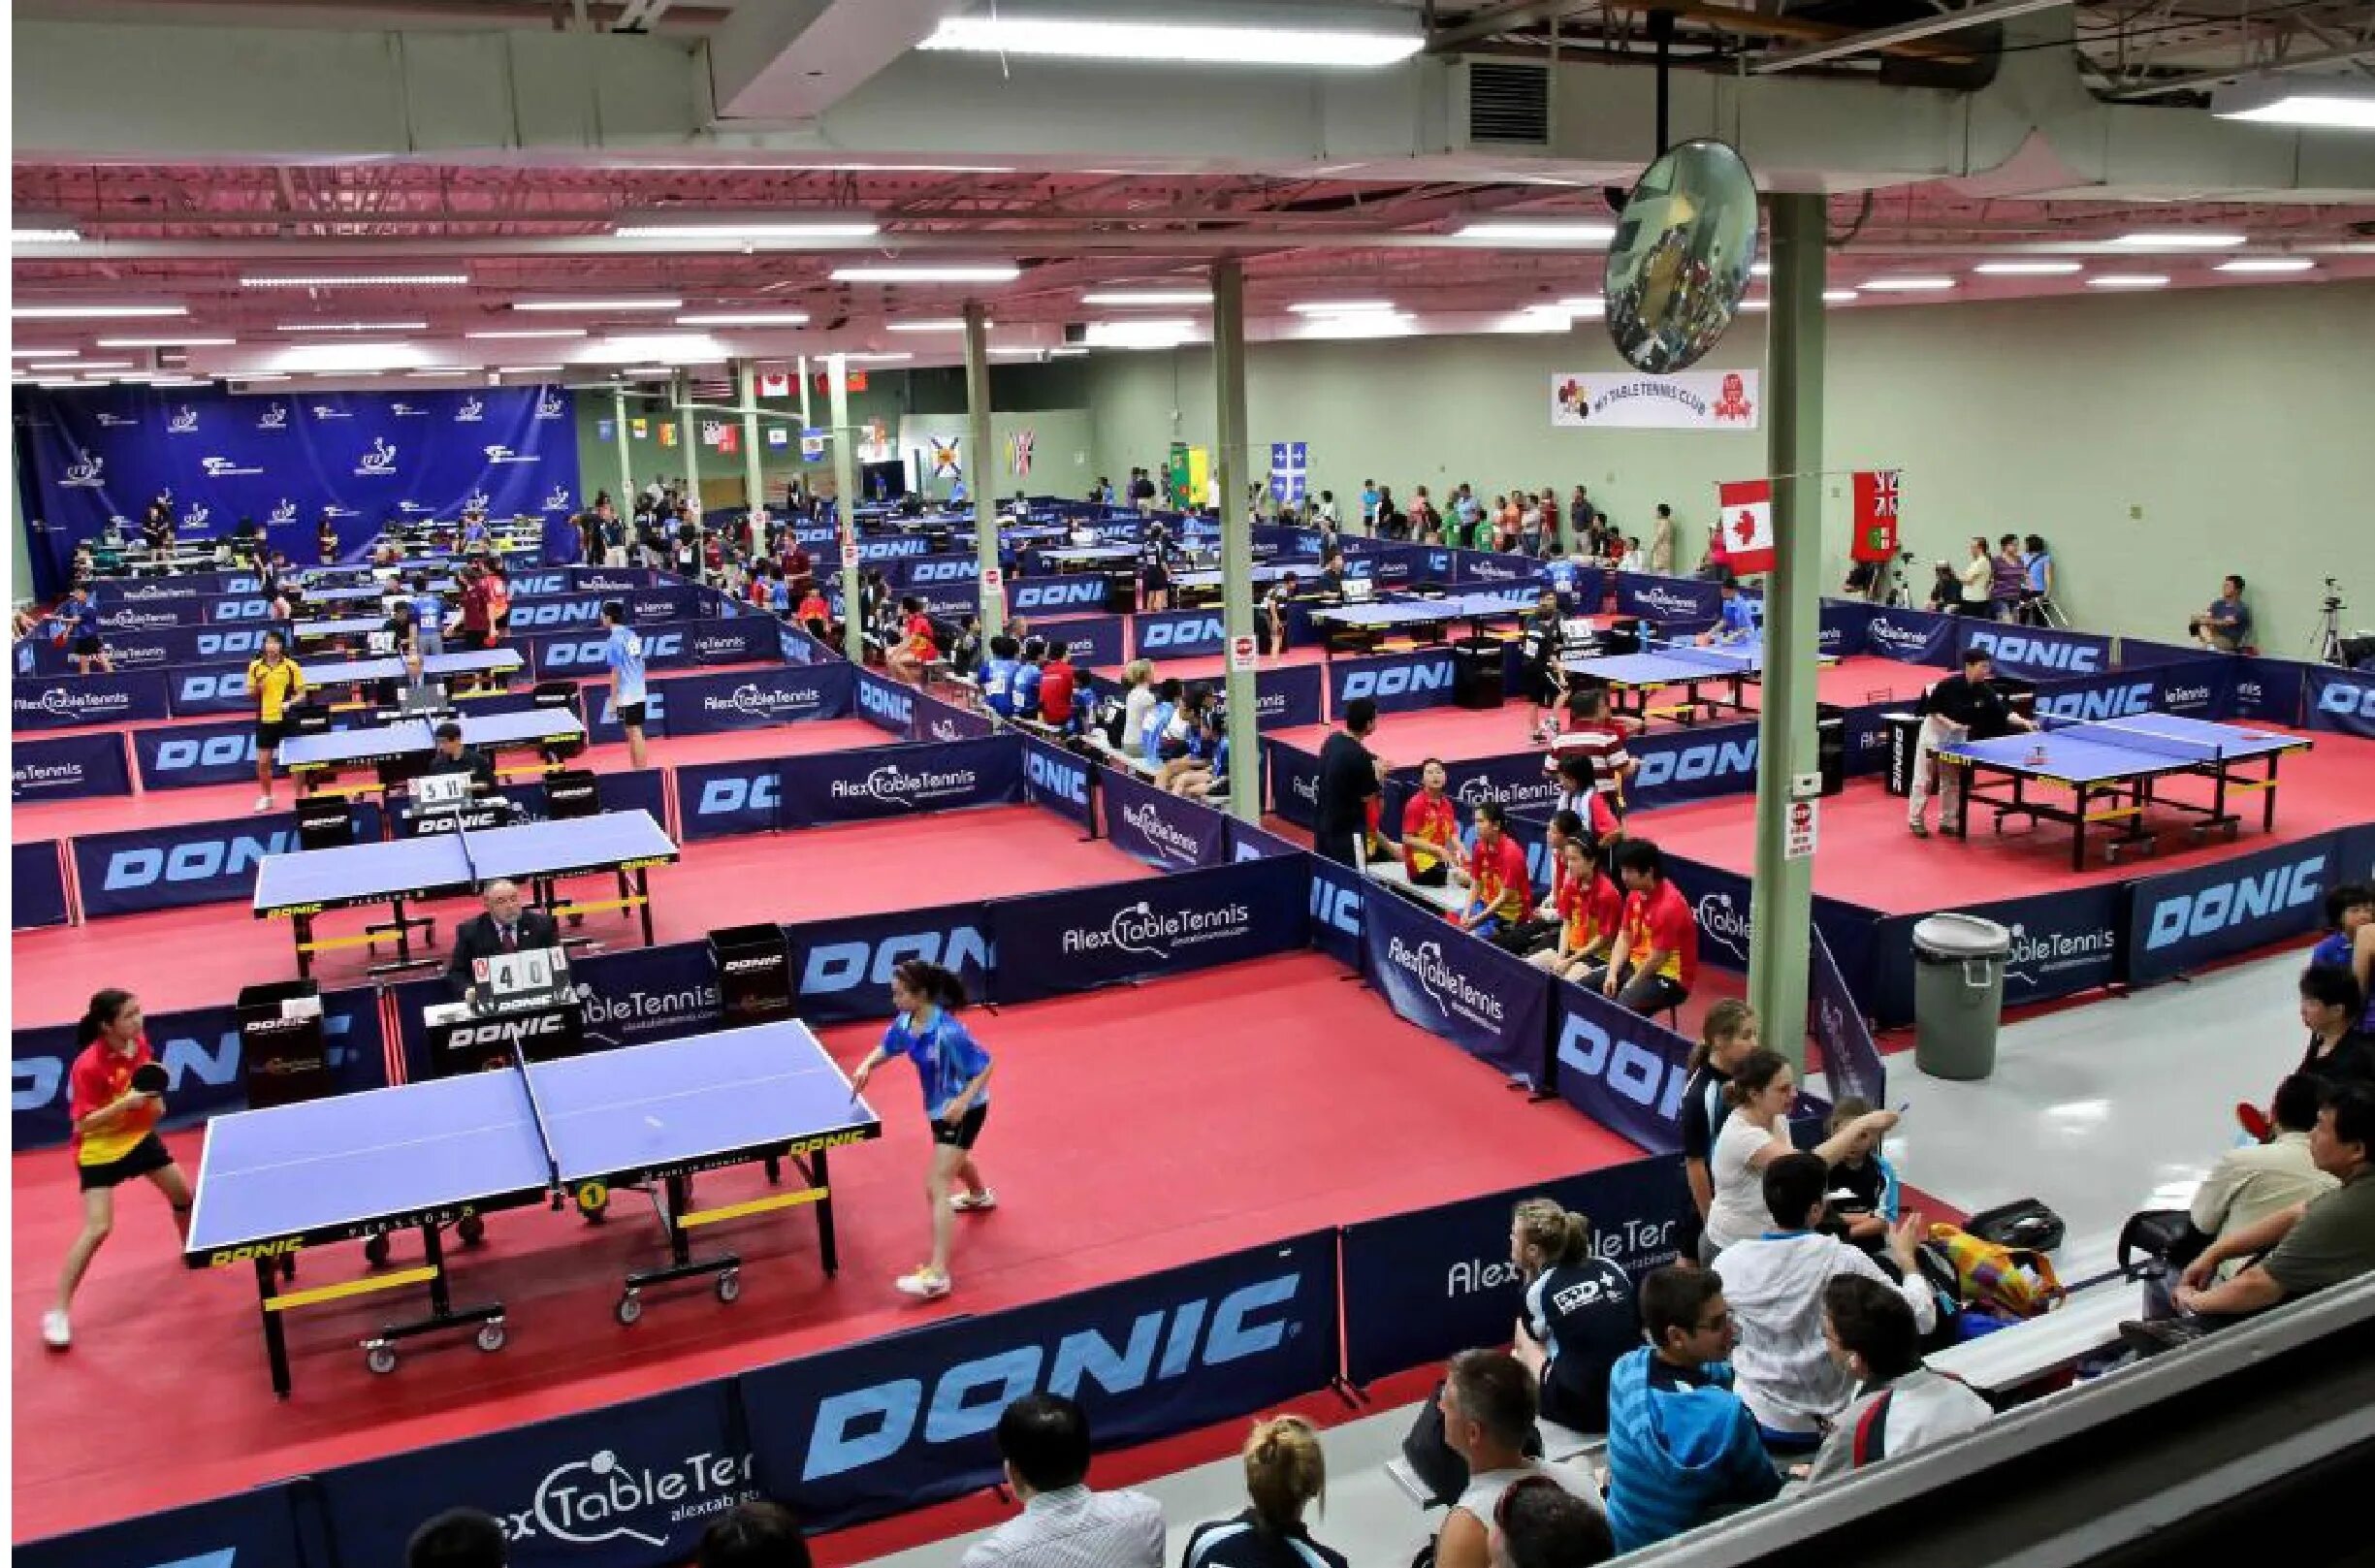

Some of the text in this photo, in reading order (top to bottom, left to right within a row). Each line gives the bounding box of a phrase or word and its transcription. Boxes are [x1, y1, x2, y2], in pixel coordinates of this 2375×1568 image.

[1609, 383, 1639, 402] TABLE
[1640, 383, 1678, 400] TENNIS
[1679, 390, 1707, 416] CLUB
[913, 560, 979, 582] DON
[1016, 582, 1105, 607] DONI
[509, 599, 602, 627] DONI
[1143, 618, 1226, 648] DON
[545, 633, 682, 667] DOIC
[1970, 631, 2100, 673] DONIC
[1341, 660, 1455, 701] DONI
[704, 688, 820, 712] AlexTableTennis
[1634, 738, 1759, 787] DON
[831, 768, 976, 798] AlexTableTennis
[104, 830, 302, 891] DON
[2146, 854, 2326, 951] DONIC
[1062, 903, 1249, 954] AlexTableTennis
[499, 964, 514, 989] 4
[530, 961, 543, 984] 0
[799, 926, 997, 995] DON
[1388, 936, 1504, 1021] AlexTableTennis
[448, 1014, 565, 1048] DONIC
[790, 1130, 866, 1158] DONIC
[587, 1186, 599, 1206] 1
[210, 1236, 305, 1267] DONIC
[802, 1272, 1302, 1484] DONIC
